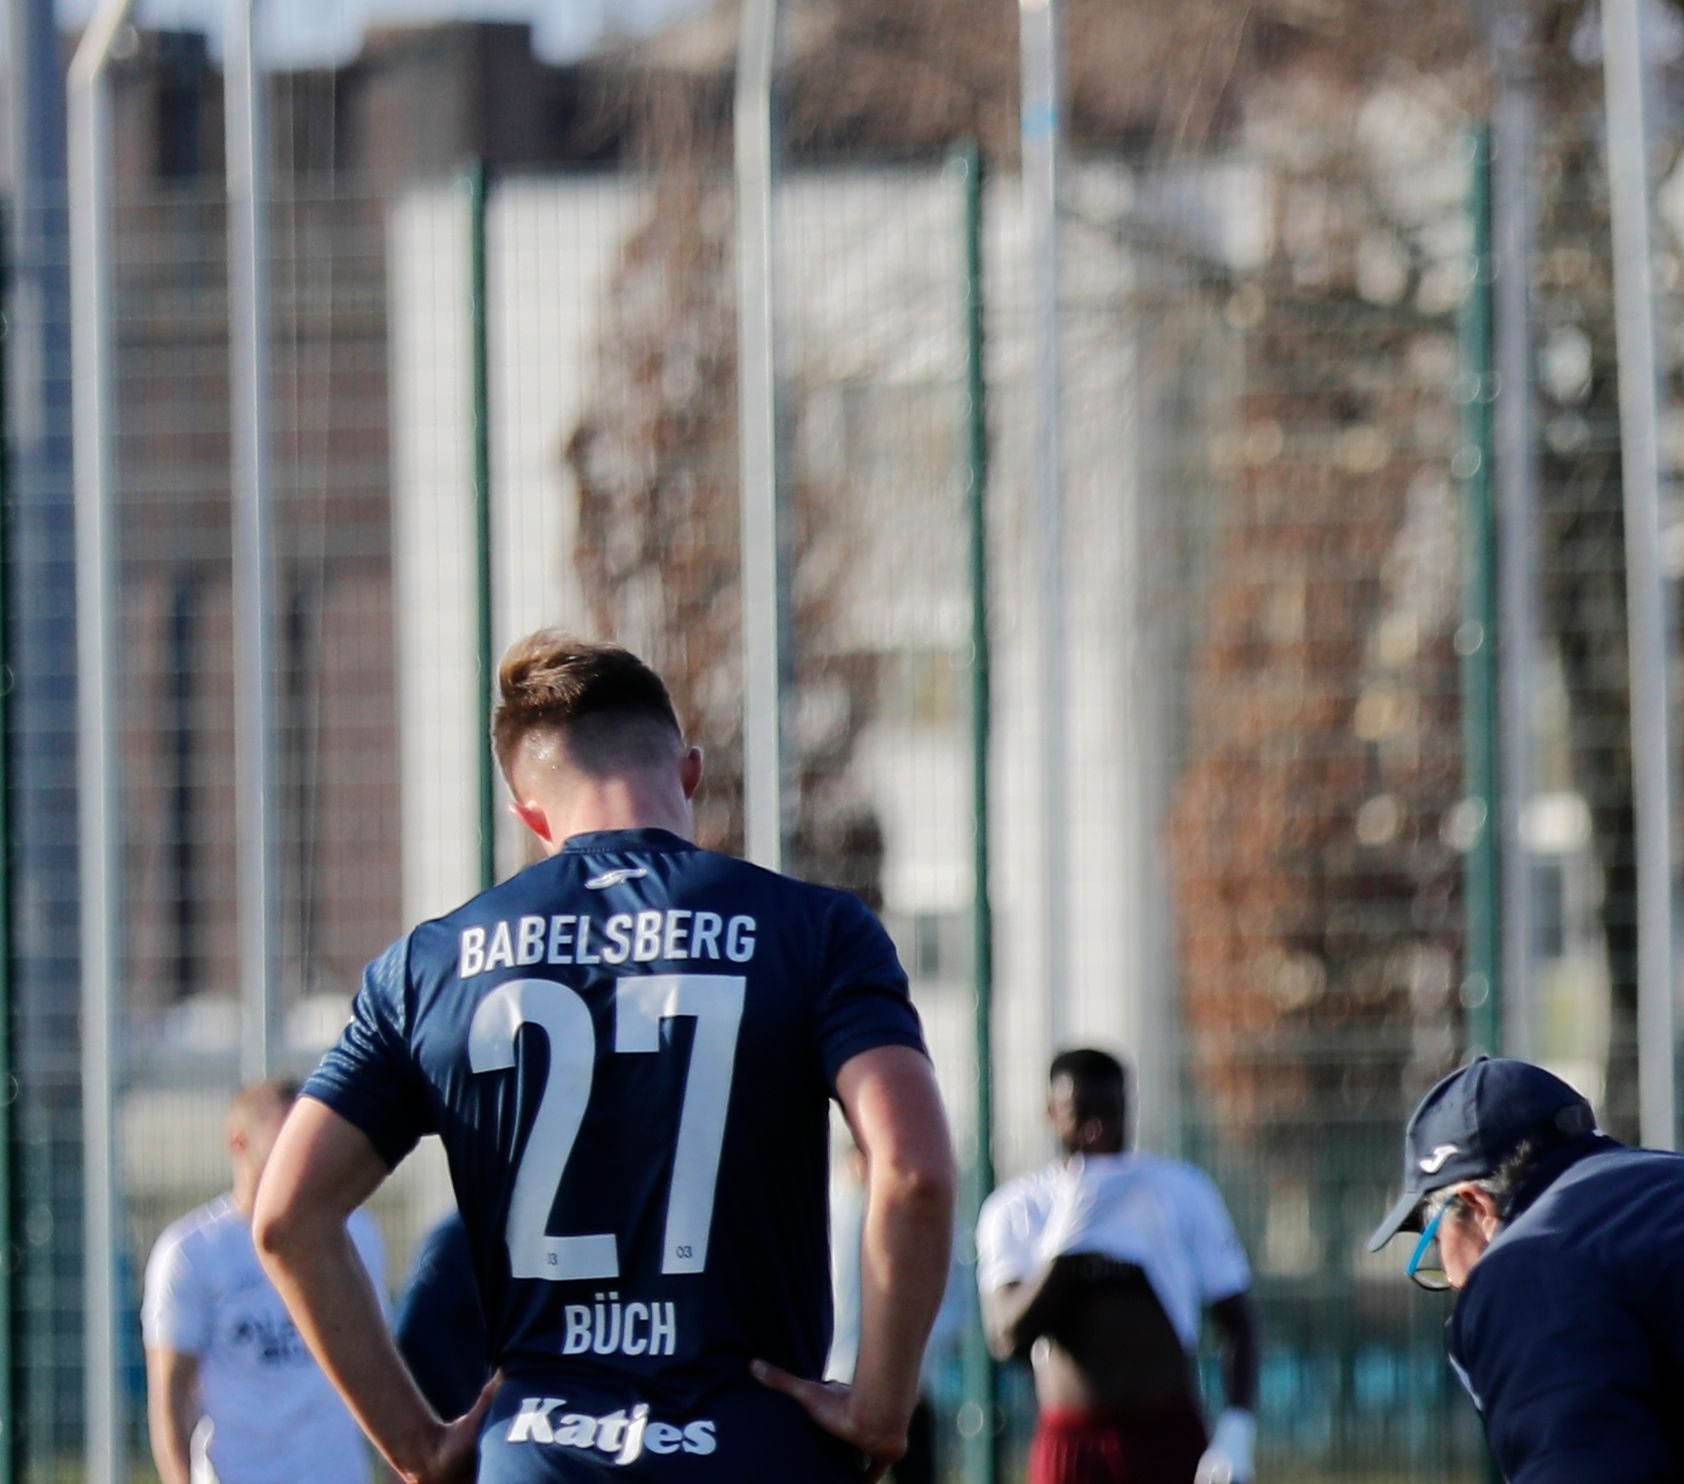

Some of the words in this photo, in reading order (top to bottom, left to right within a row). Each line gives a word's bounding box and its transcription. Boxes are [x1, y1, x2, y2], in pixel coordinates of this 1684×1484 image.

[459, 910, 757, 979] BABELSBERG
[468, 974, 747, 1281] 27
[562, 1292, 676, 1356] BÜCH
[507, 1397, 717, 1466] Katjes
